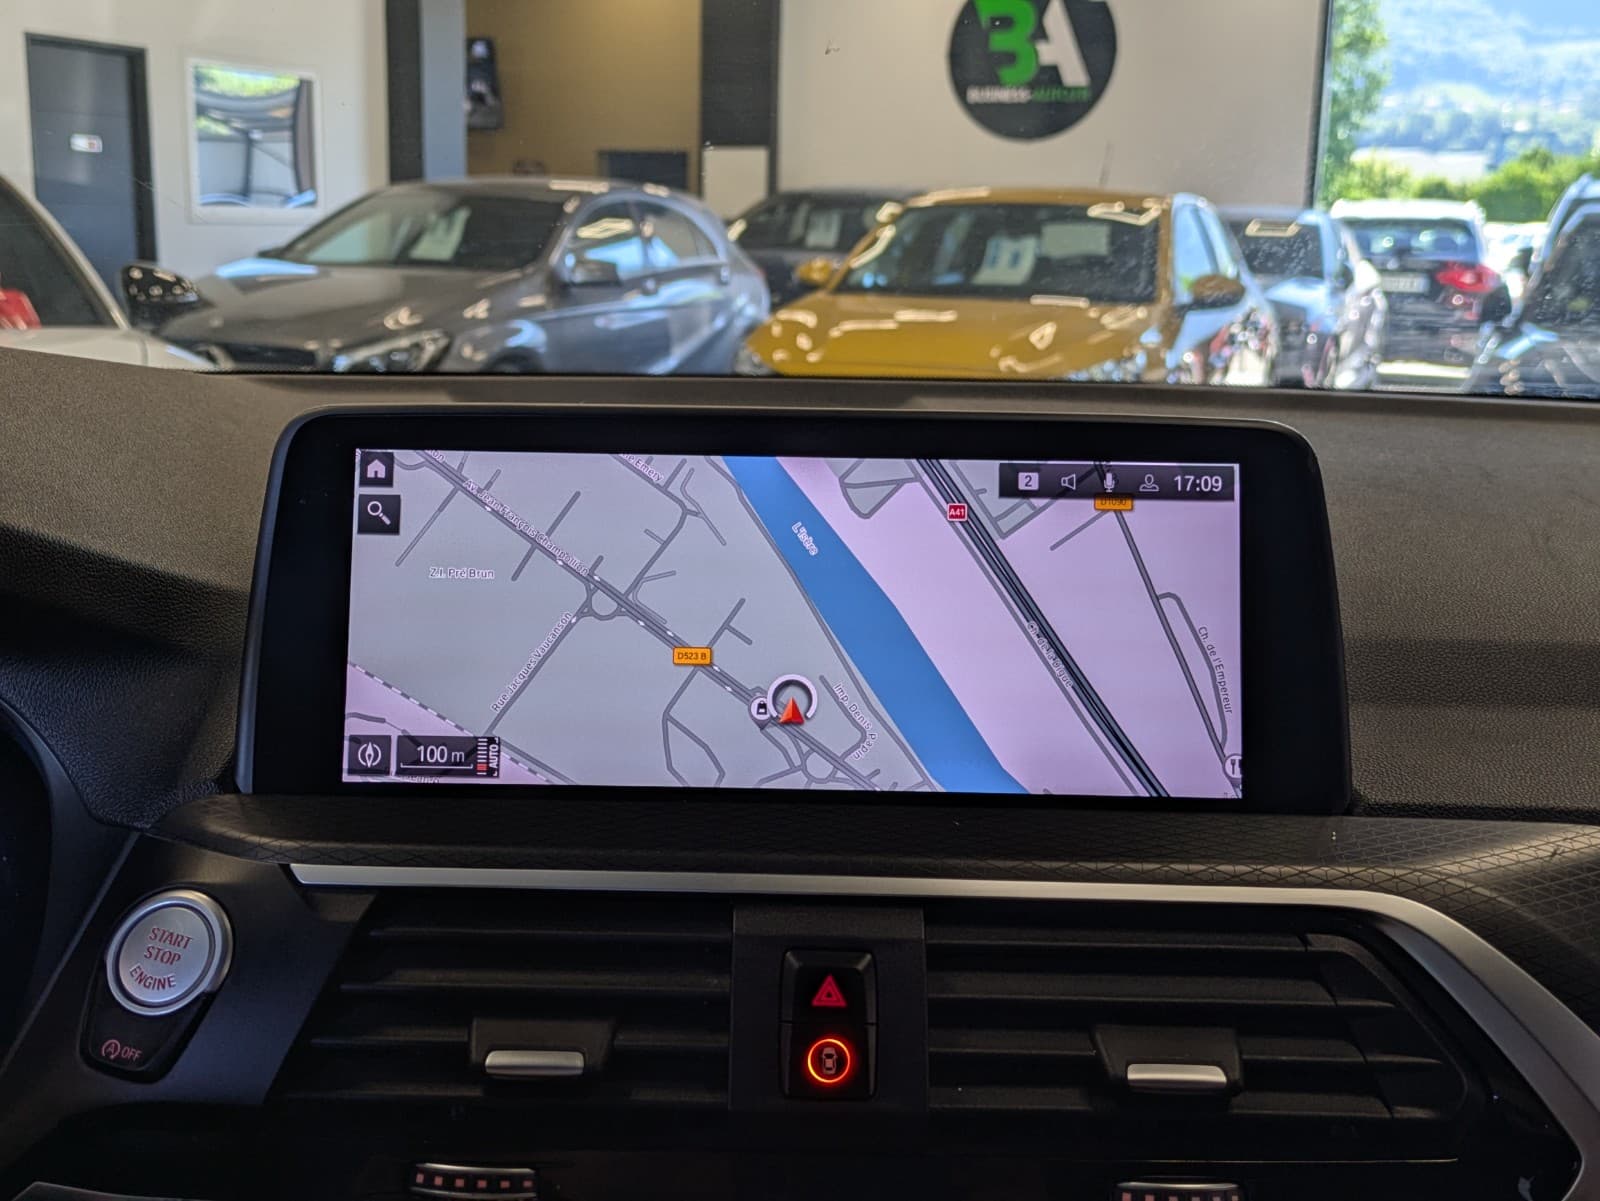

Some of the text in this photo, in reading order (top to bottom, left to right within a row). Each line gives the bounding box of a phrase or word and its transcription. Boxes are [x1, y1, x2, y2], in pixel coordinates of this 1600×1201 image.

[1024, 475, 1223, 492] 2 17:09
[949, 508, 964, 516] A41
[463, 480, 589, 576] Av. Jean François Champollion
[468, 567, 495, 579] Brun
[491, 612, 572, 712] Rue Jacques Vaucanson
[677, 652, 707, 660] D523 B
[1198, 626, 1233, 714] Ch. de l'Empereur
[834, 683, 849, 705] Imp.
[848, 703, 872, 730] Denis
[417, 746, 465, 763] 100 m
[489, 744, 499, 769] AUTO
[149, 927, 193, 949] START
[144, 945, 181, 966] STOP
[129, 964, 177, 991] ENGINE
[121, 1047, 142, 1061] OFF
